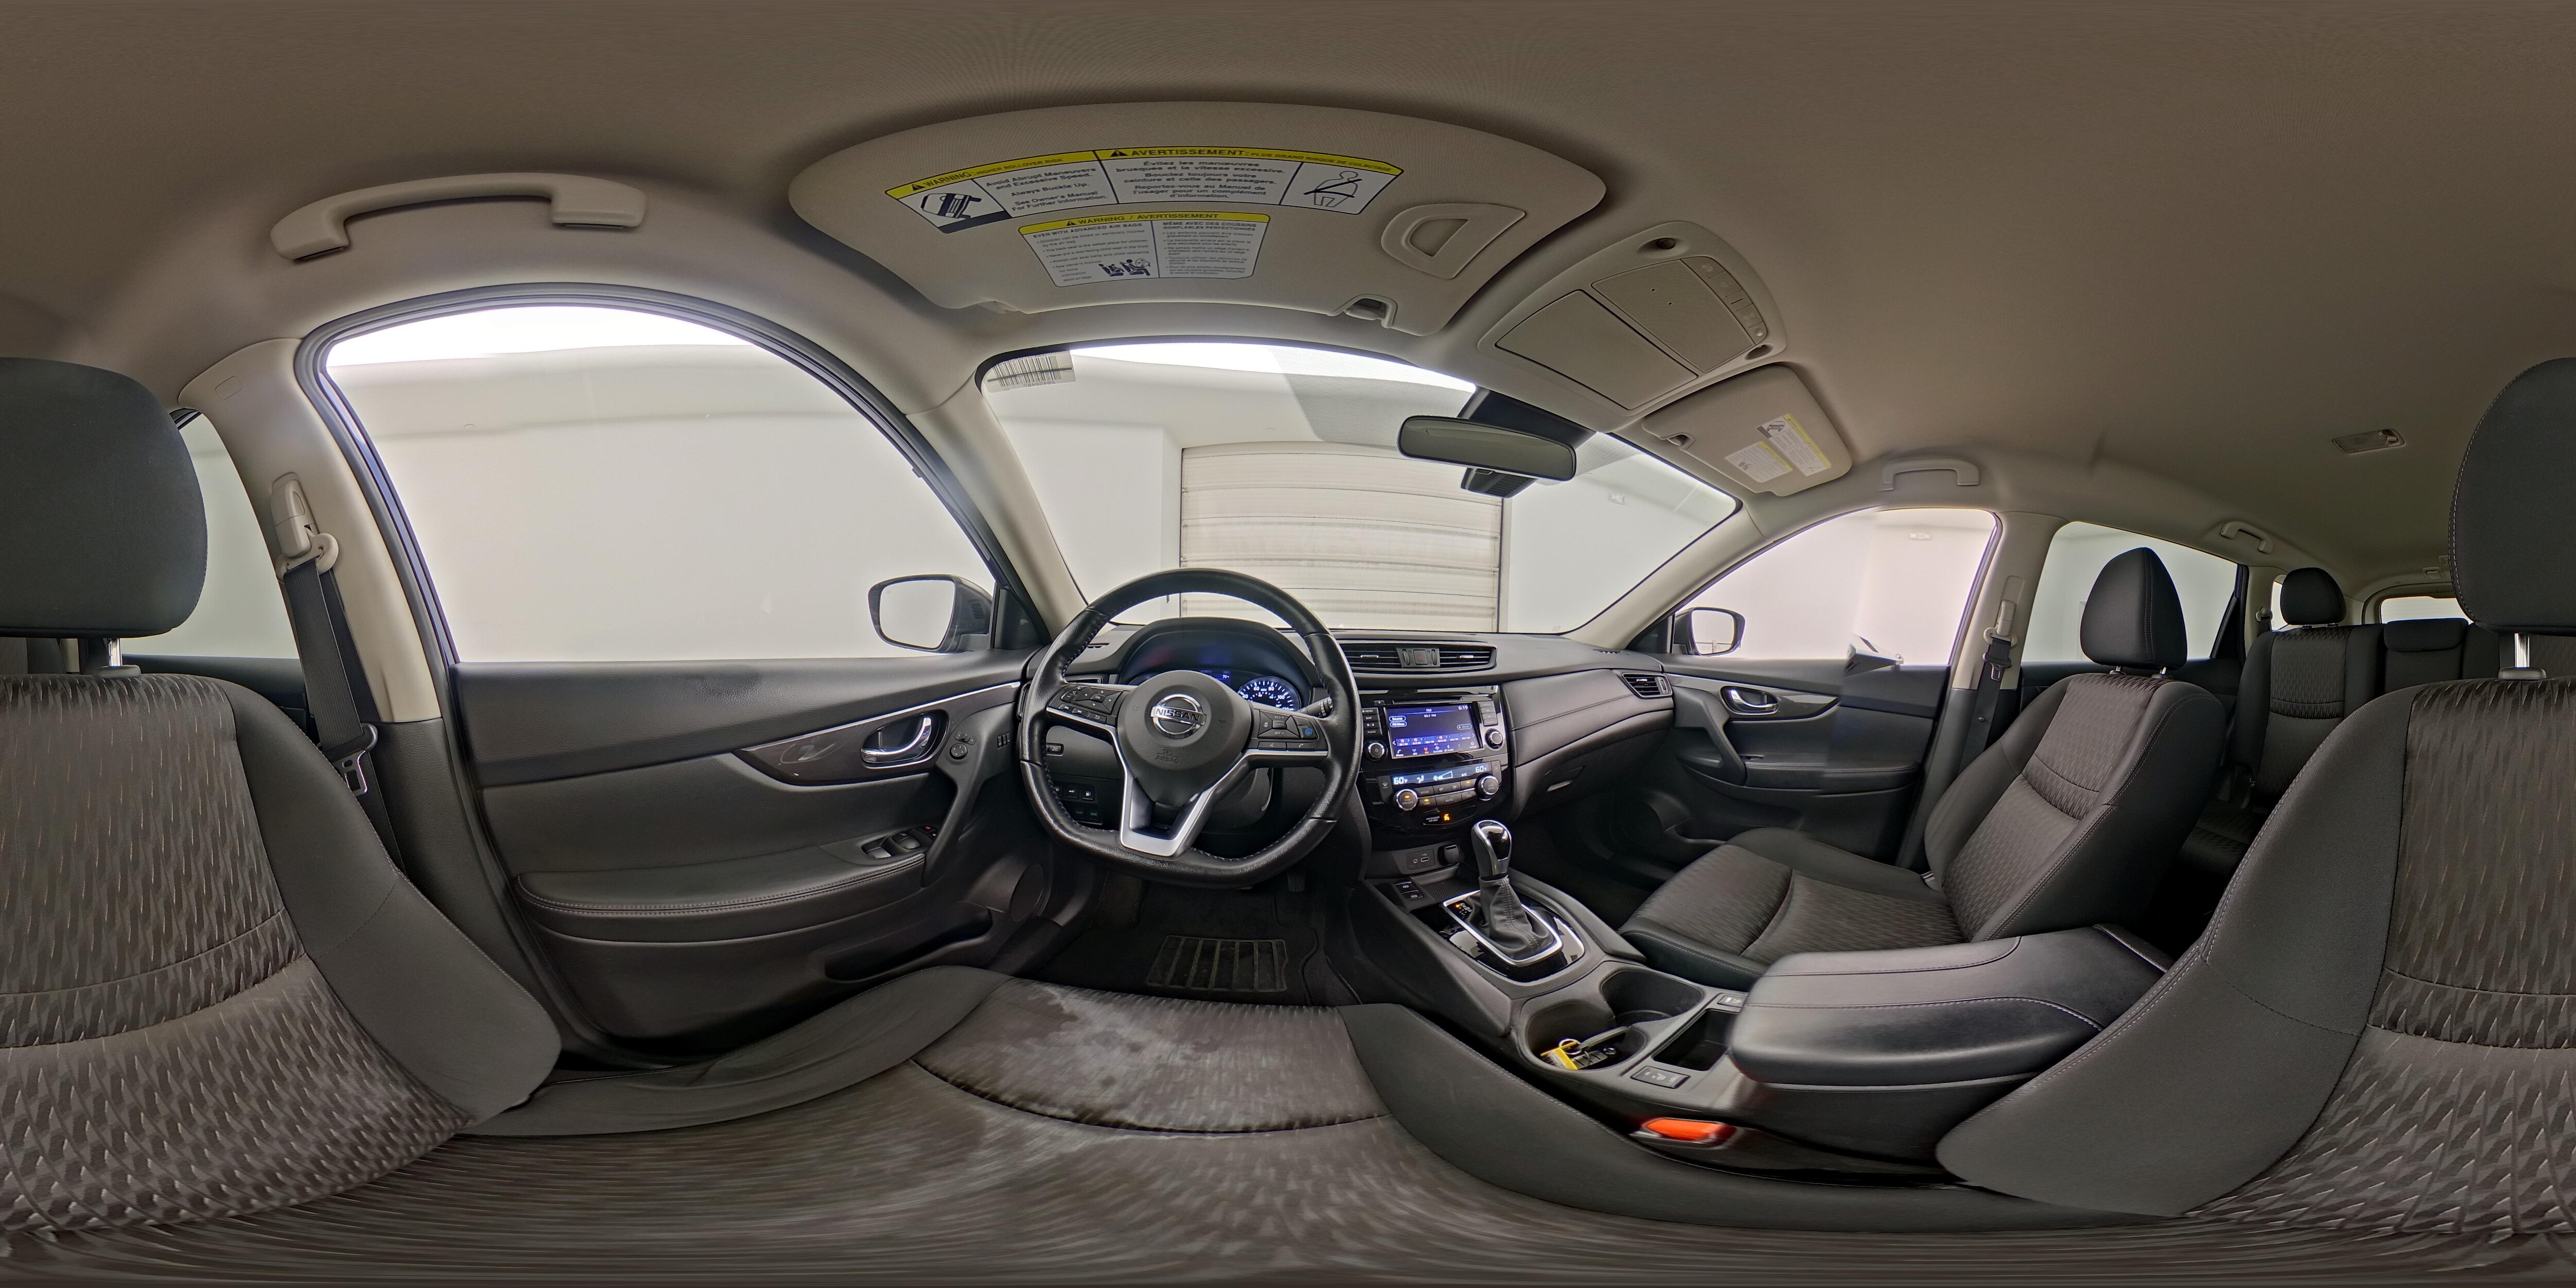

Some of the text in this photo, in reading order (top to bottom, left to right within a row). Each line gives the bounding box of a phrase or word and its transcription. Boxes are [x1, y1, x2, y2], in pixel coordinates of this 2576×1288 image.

[977, 167, 1002, 175] HIGHER
[1004, 161, 1042, 171] ROLLOVER
[1348, 161, 1392, 172] CULBUTAGE
[1012, 174, 1042, 183] Abrupt
[1044, 167, 1096, 177] Maneuvers
[1013, 177, 1058, 187] Excessive
[1060, 173, 1092, 181] Speed.
[1011, 188, 1040, 197] Always
[1027, 200, 1056, 209] Further
[1058, 195, 1108, 204] Information.
[1031, 195, 1065, 204] Owner's
[1077, 216, 1125, 224] WARNING
[1155, 708, 1199, 721] NISSAN
[1155, 755, 1179, 764] AIRBAG
